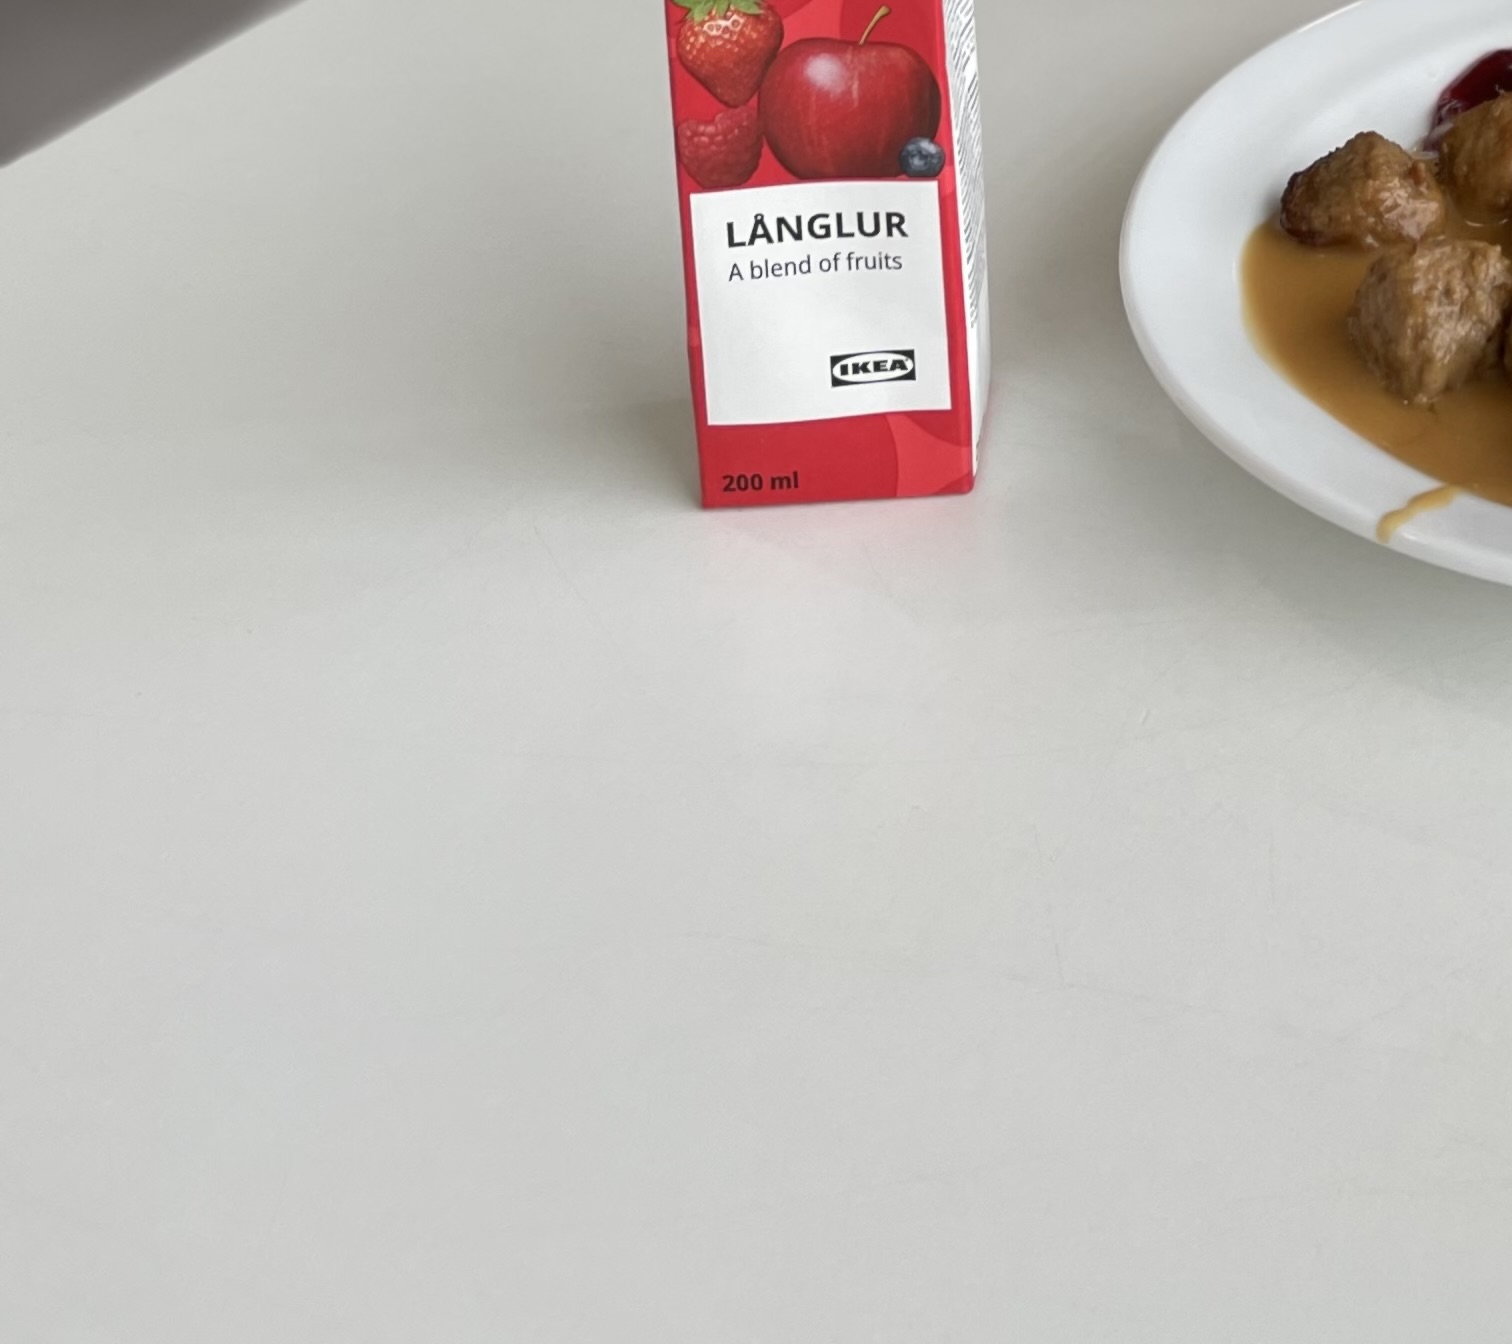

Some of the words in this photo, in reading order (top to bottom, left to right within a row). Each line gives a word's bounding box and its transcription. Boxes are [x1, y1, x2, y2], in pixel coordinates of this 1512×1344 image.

[726, 212, 908, 248] LÅNGLUR
[728, 263, 744, 281] A
[750, 255, 811, 279] blend
[819, 252, 842, 272] of
[847, 251, 902, 271] fruits
[840, 359, 907, 376] IKEA
[722, 474, 763, 492] 200
[771, 471, 799, 490] ml
